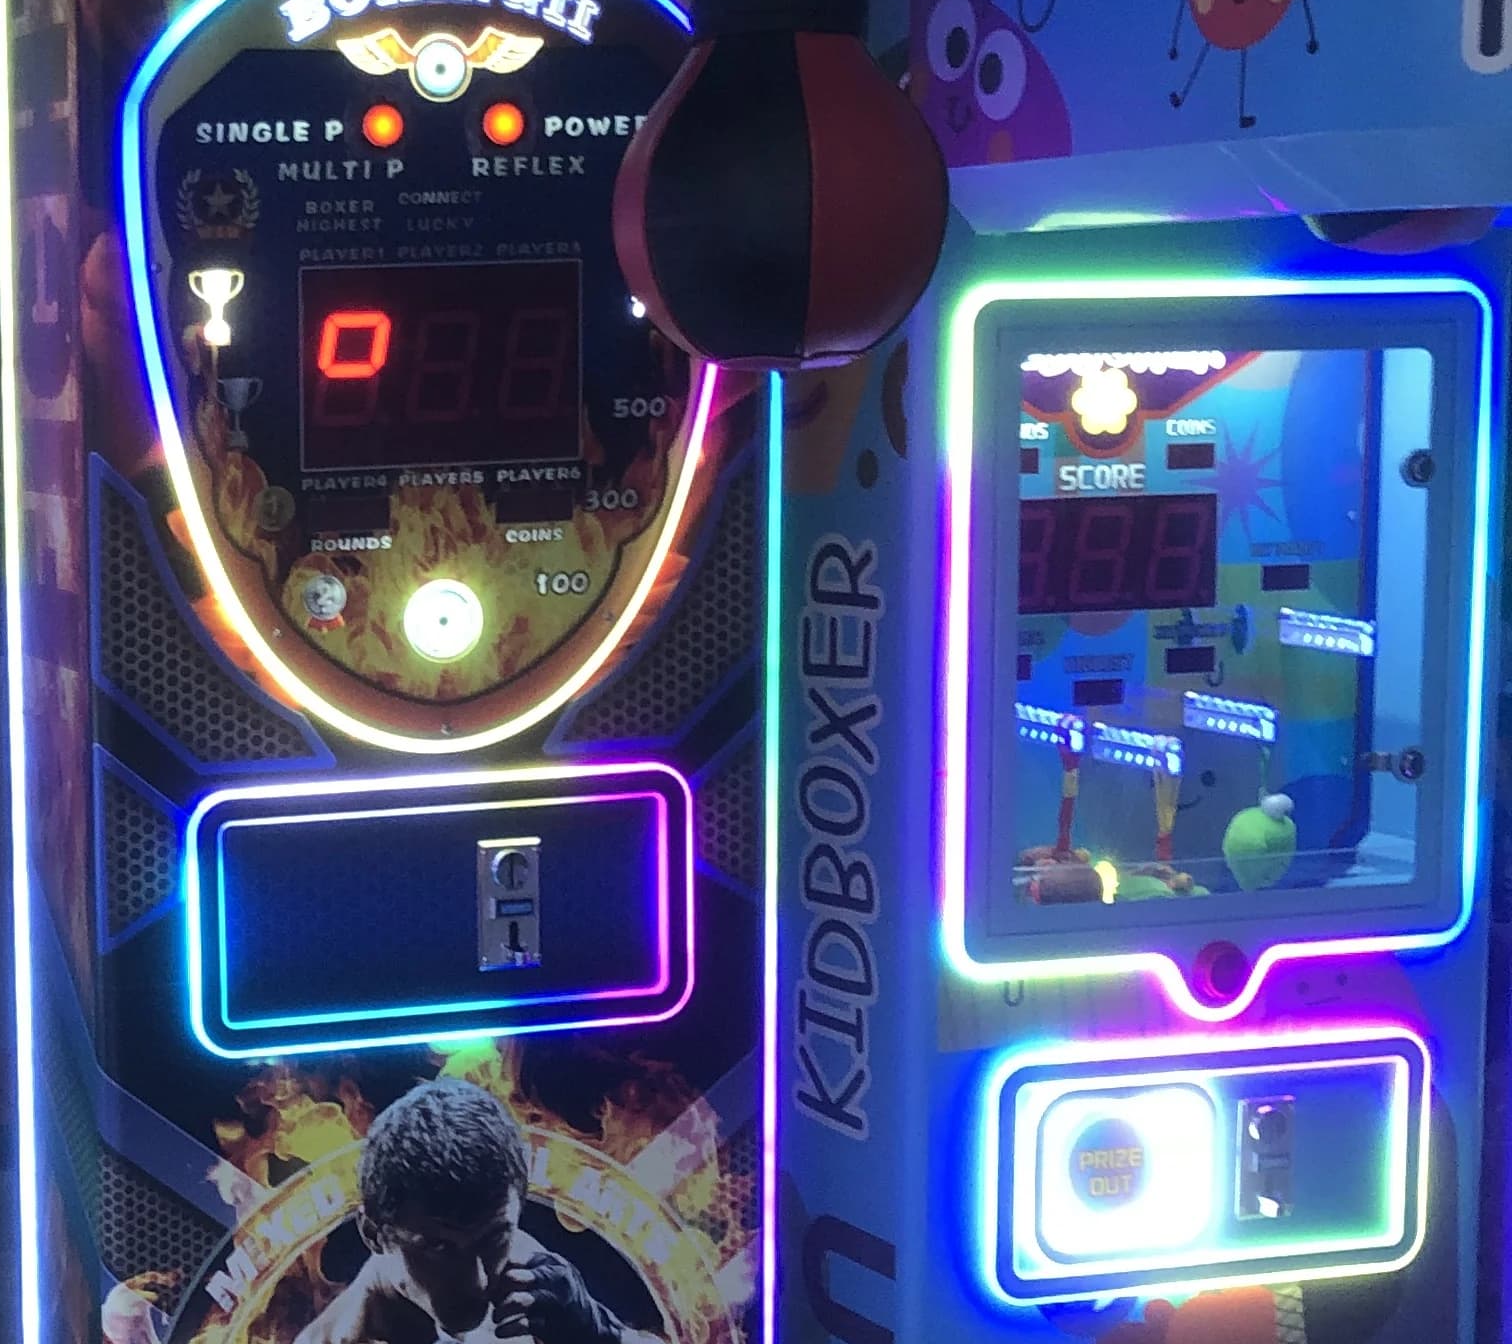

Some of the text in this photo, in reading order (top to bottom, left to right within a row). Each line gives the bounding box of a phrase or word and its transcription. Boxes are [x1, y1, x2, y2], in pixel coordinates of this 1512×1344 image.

[196, 119, 344, 143] SINGLE P
[278, 159, 404, 182] MULTI P
[473, 155, 585, 177] REFLEX
[304, 199, 375, 214] BOXER
[398, 191, 483, 206] CONNECT
[296, 218, 383, 233] HIGHEST
[406, 217, 474, 232] LUCKY
[299, 247, 384, 262] PLAYER1
[397, 244, 484, 260] PLAYER2
[613, 397, 667, 419] 500
[301, 474, 388, 491] PLAYER4
[399, 470, 485, 487] PLAYER5
[496, 466, 582, 482] PLAYER6
[1059, 464, 1147, 492] SCORE
[584, 489, 638, 511] 300
[310, 535, 393, 553] ROUNDS
[505, 529, 564, 544] COINS
[534, 572, 590, 595] 100
[793, 537, 883, 1135] KIDBOXER
[1079, 1146, 1144, 1171] PRIZE
[1090, 1174, 1135, 1196] OUT
